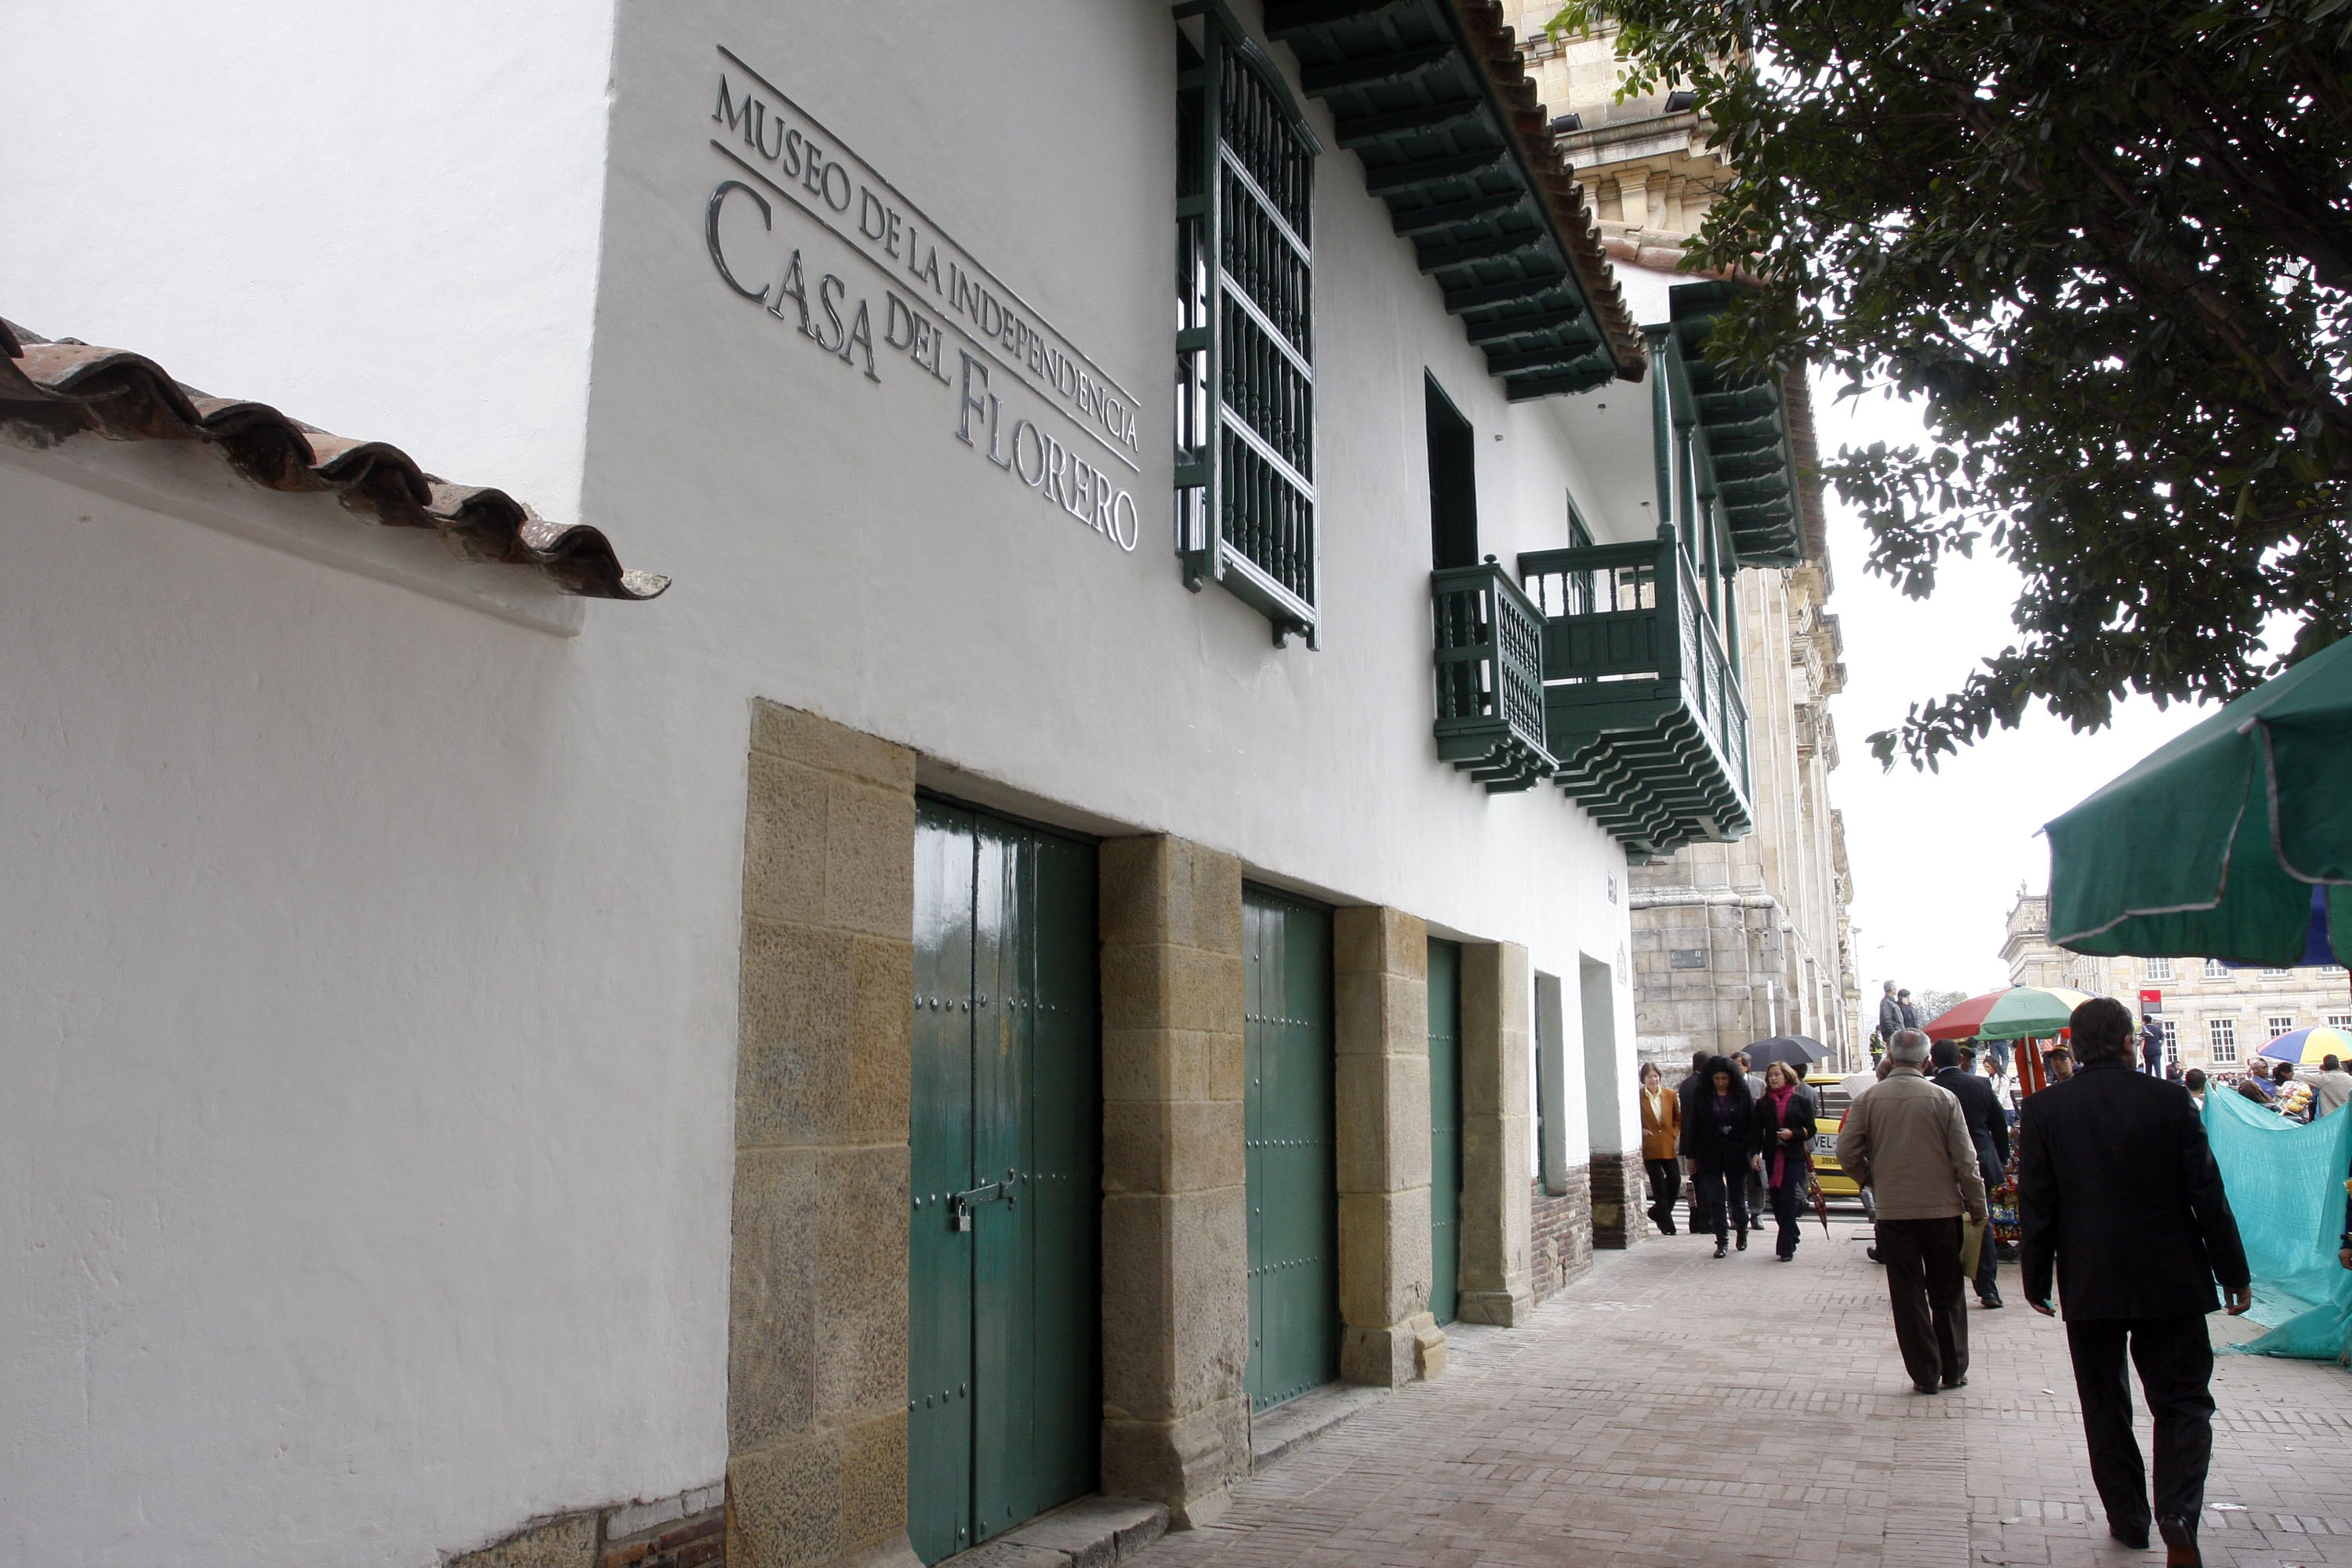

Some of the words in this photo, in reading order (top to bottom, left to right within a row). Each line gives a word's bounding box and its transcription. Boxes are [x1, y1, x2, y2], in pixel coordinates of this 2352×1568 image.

[706, 180, 881, 383] CASA
[884, 289, 952, 386] DEL
[955, 348, 1138, 552] FLORERO
[712, 72, 851, 212] MUSEO
[858, 185, 902, 259] DE
[909, 226, 943, 296] LA
[949, 261, 1139, 452] INDEPENDENCIA
